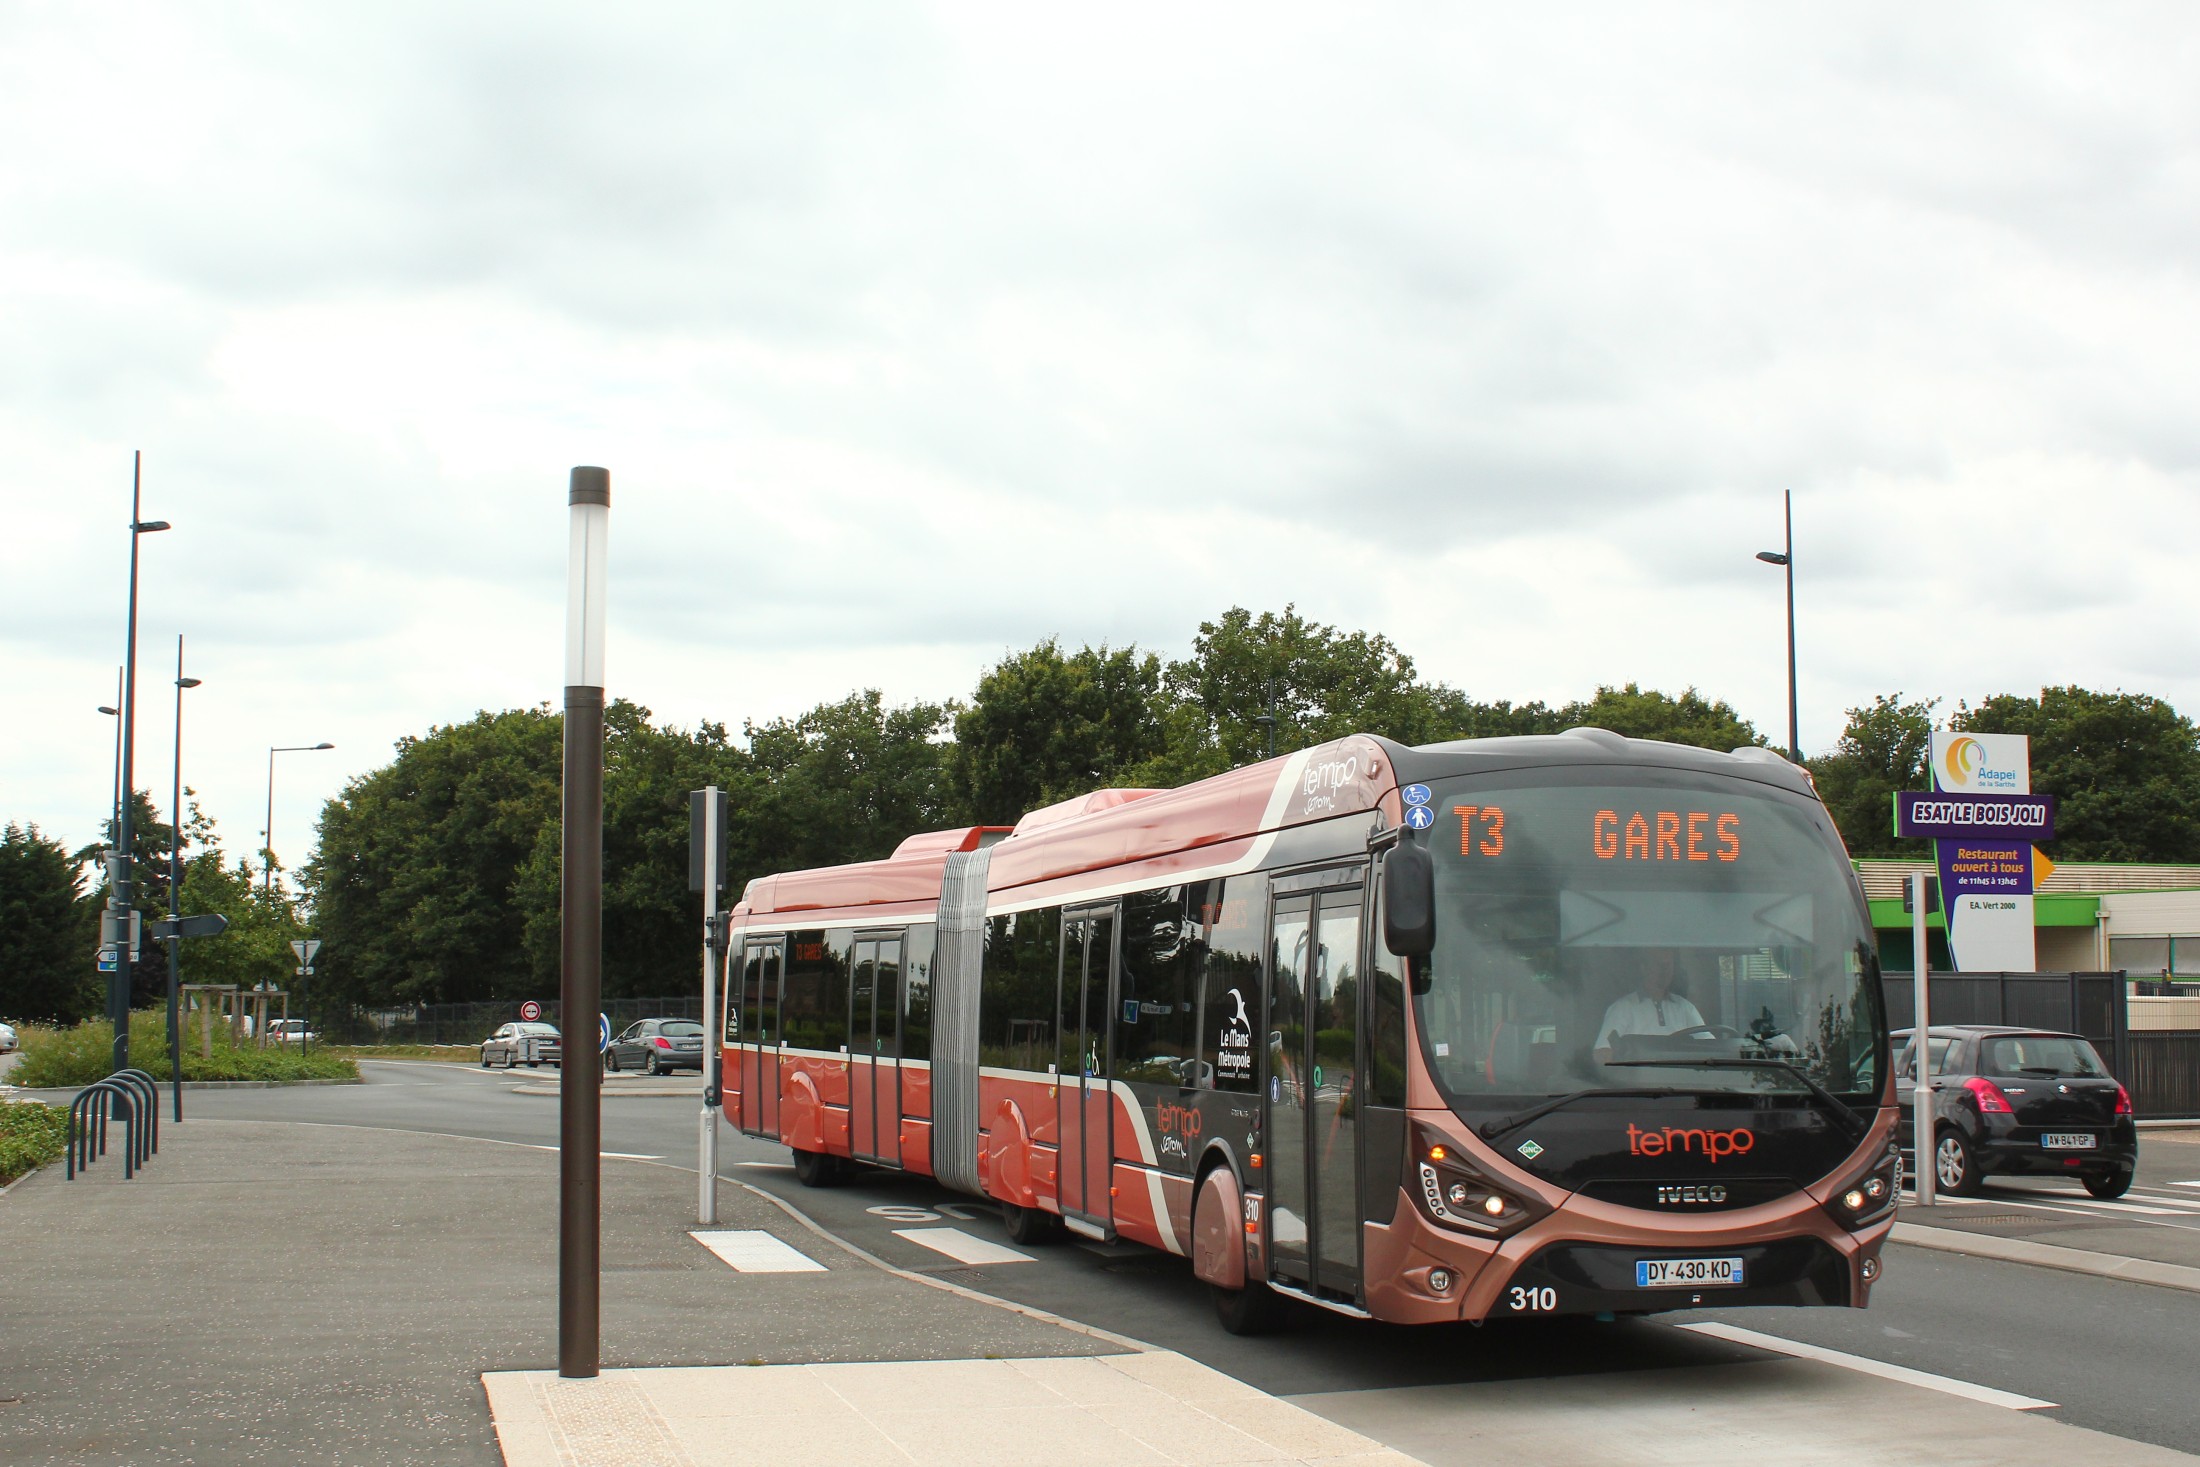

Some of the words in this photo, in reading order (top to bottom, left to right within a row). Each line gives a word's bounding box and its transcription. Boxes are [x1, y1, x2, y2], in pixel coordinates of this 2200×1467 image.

[1303, 756, 1356, 797] tempo
[1978, 767, 2016, 781] Adapei
[1913, 802, 1952, 823] ESAT
[1953, 803, 1973, 824] LE
[1974, 803, 2010, 825] BOIS
[2010, 805, 2045, 825] JOLI
[1453, 805, 1505, 856] T3
[1594, 810, 1740, 861] GARES
[1957, 848, 2018, 860] Restaurant
[1951, 862, 1989, 873] ouvert
[1991, 861, 1998, 873] à
[2000, 862, 2024, 873] tous
[1958, 876, 1968, 885] de
[1991, 876, 1996, 885] à
[1969, 901, 1982, 910] EA.
[1982, 901, 1999, 910] Vert
[2000, 902, 2016, 910] 2000
[1220, 1029, 1229, 1047] Le
[1229, 1028, 1249, 1048] Mans
[1217, 1049, 1251, 1073] Métropole
[1156, 1095, 1202, 1147] tempo
[1522, 1146, 1539, 1154] GNC
[1626, 1122, 1754, 1163] tempo
[1658, 1185, 1727, 1204] IVECO
[1245, 1198, 1259, 1222] 310
[1649, 1260, 1731, 1280] DY-430-KD
[1509, 1286, 1557, 1311] 310
